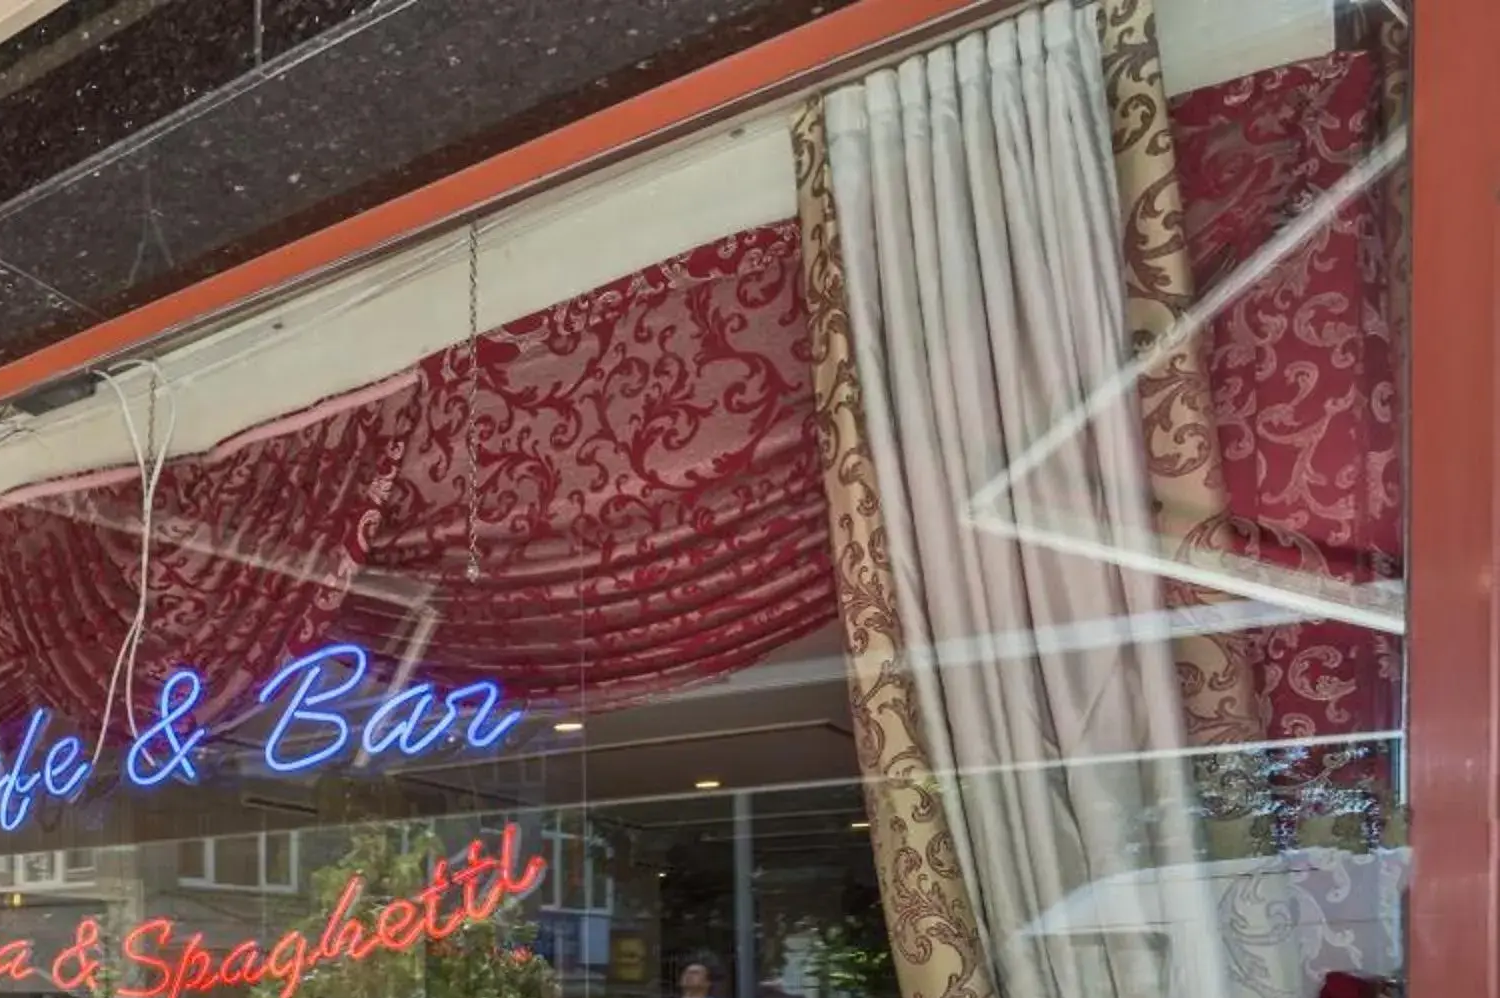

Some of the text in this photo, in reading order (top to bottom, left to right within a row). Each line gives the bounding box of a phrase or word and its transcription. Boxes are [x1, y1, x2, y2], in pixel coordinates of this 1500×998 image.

[125, 670, 204, 786] &
[260, 643, 522, 773] Bar
[51, 918, 102, 990] &
